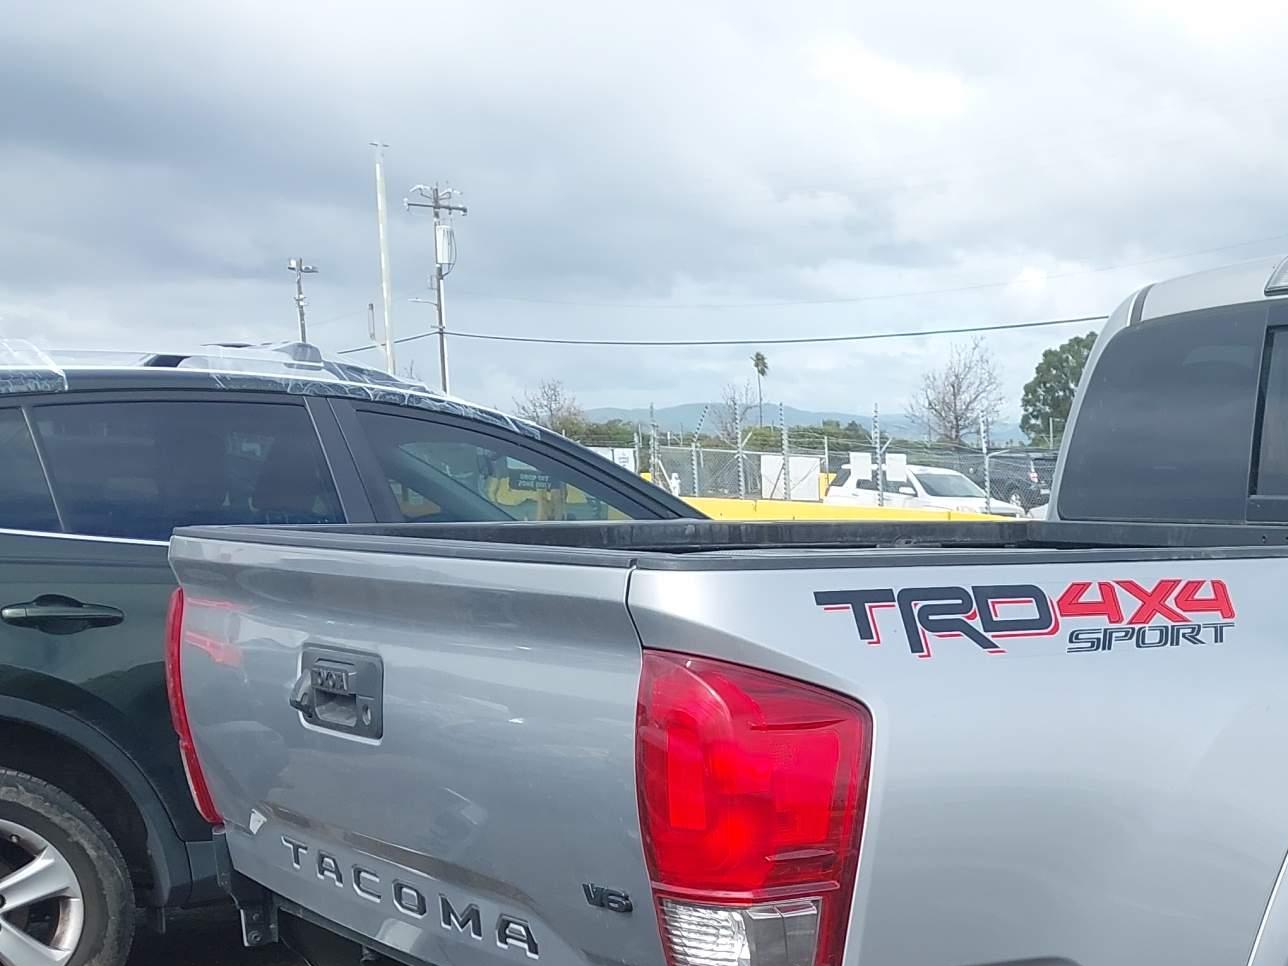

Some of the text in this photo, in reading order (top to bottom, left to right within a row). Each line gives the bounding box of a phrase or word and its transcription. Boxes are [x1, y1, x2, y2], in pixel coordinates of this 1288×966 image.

[814, 584, 1060, 658] TRD
[1066, 622, 1236, 653] SPORT
[281, 836, 540, 960] TACOMA
[582, 881, 633, 912] V6
